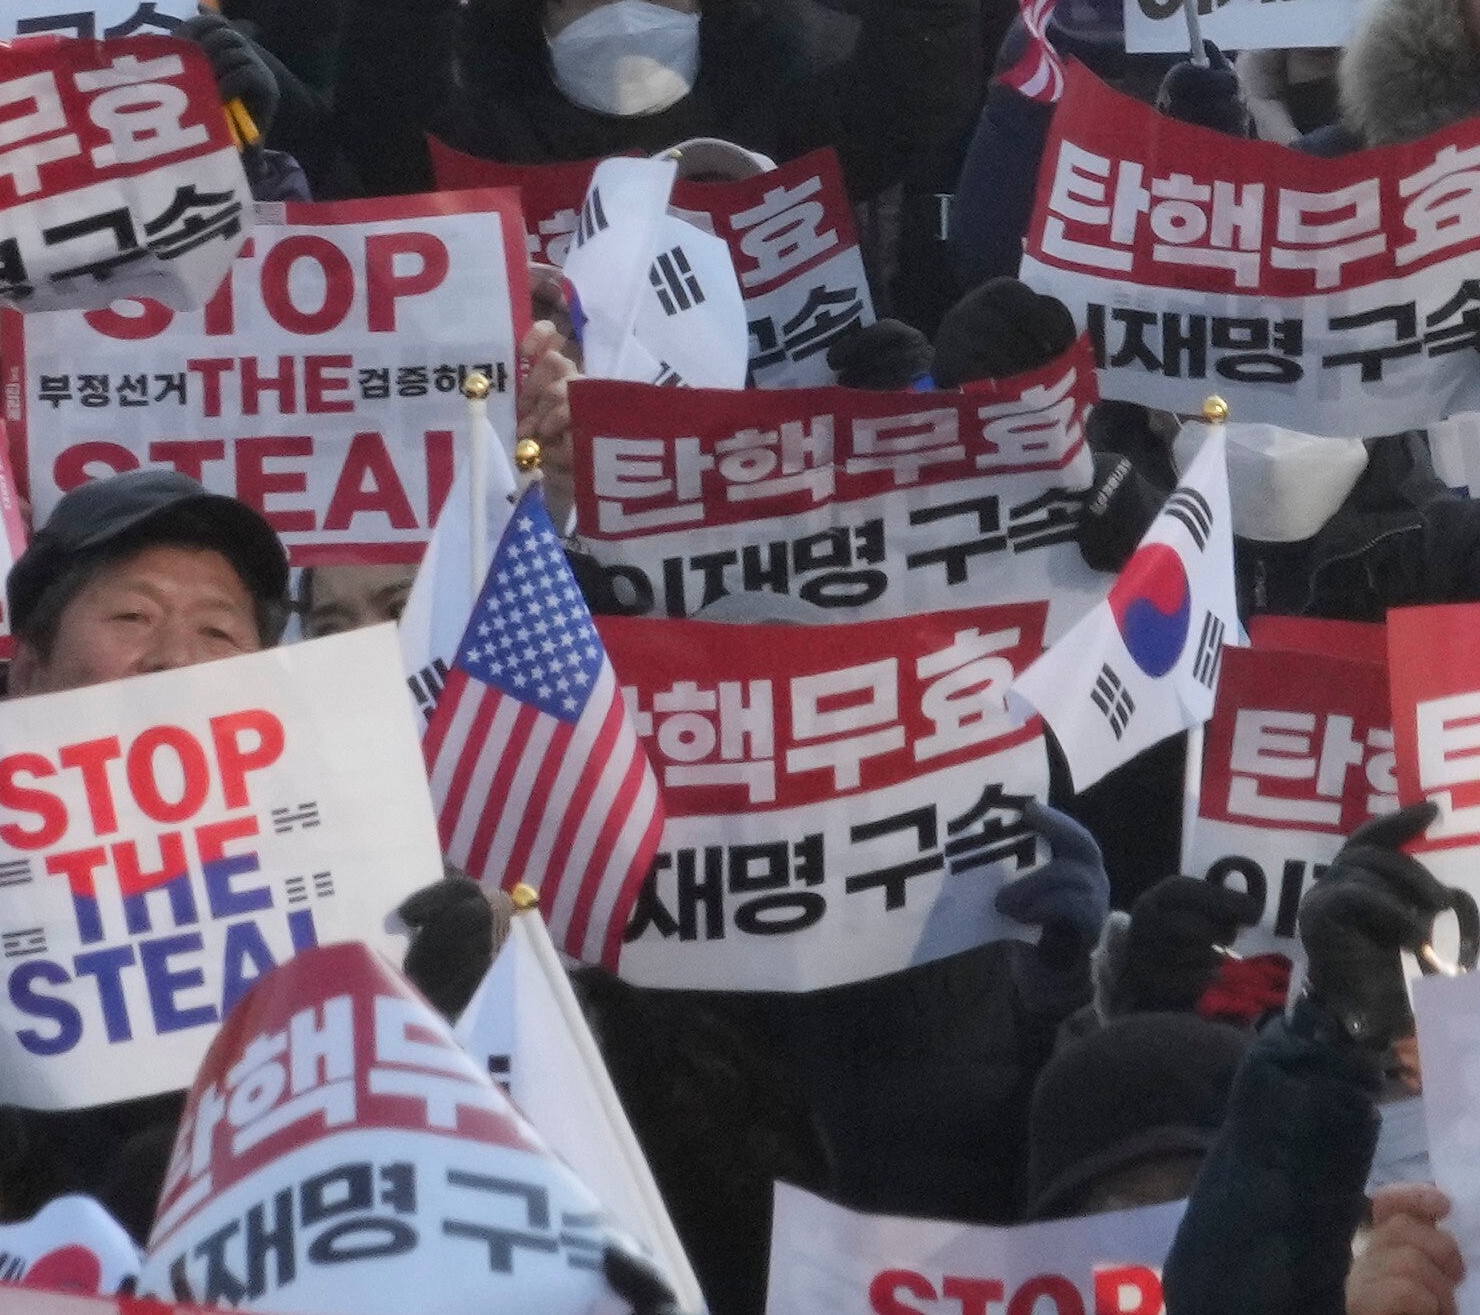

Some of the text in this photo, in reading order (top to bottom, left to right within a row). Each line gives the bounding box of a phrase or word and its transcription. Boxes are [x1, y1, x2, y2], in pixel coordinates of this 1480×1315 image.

[39, 356, 356, 416] 부정선거 THE
[593, 364, 1093, 535] 탄핵무효
[45, 818, 274, 945] THE
[622, 824, 824, 943] 재명
[6, 910, 319, 1056] STEA
